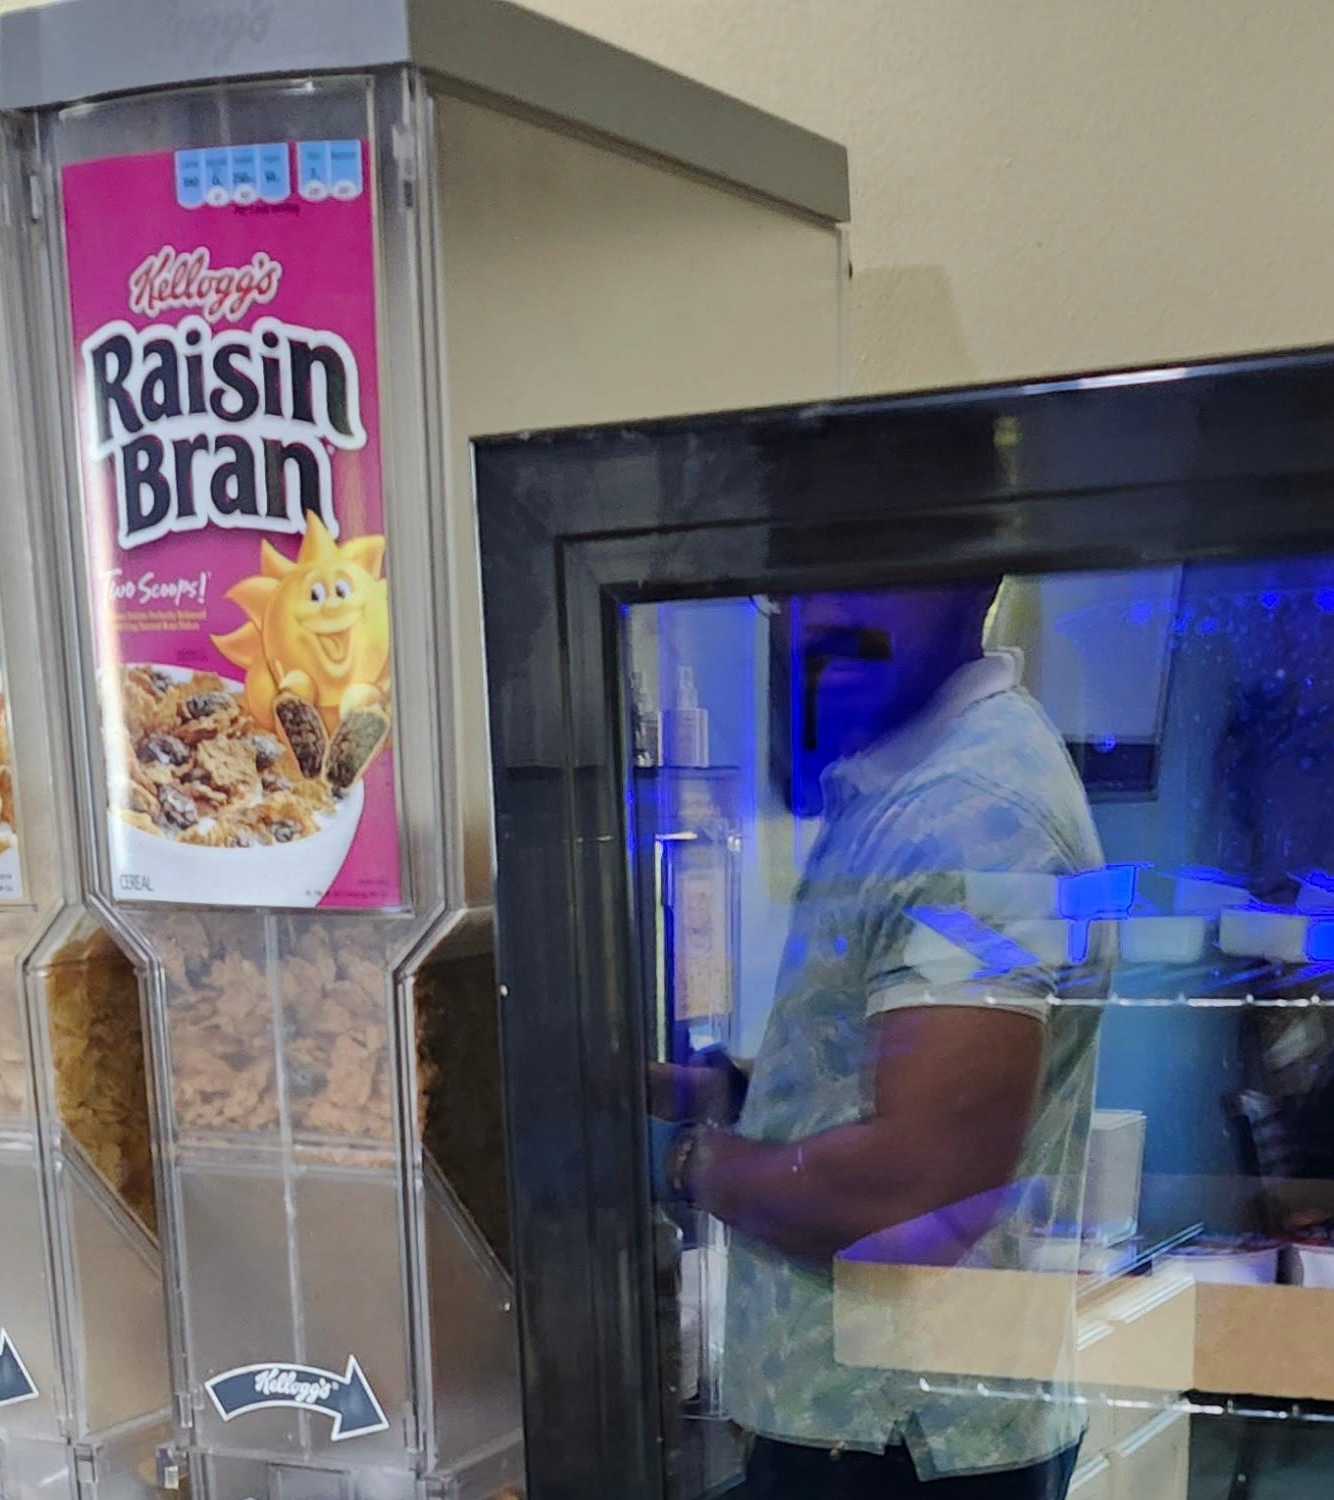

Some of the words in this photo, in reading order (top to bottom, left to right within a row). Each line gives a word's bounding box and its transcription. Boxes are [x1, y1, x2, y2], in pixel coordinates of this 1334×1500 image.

[131, 248, 280, 319] Kellogg's
[91, 328, 355, 439] Raisin
[121, 433, 324, 535] Bran
[137, 570, 207, 606] Scoops!
[119, 875, 154, 892] CEREAL
[254, 1367, 332, 1404] Kellogg's
